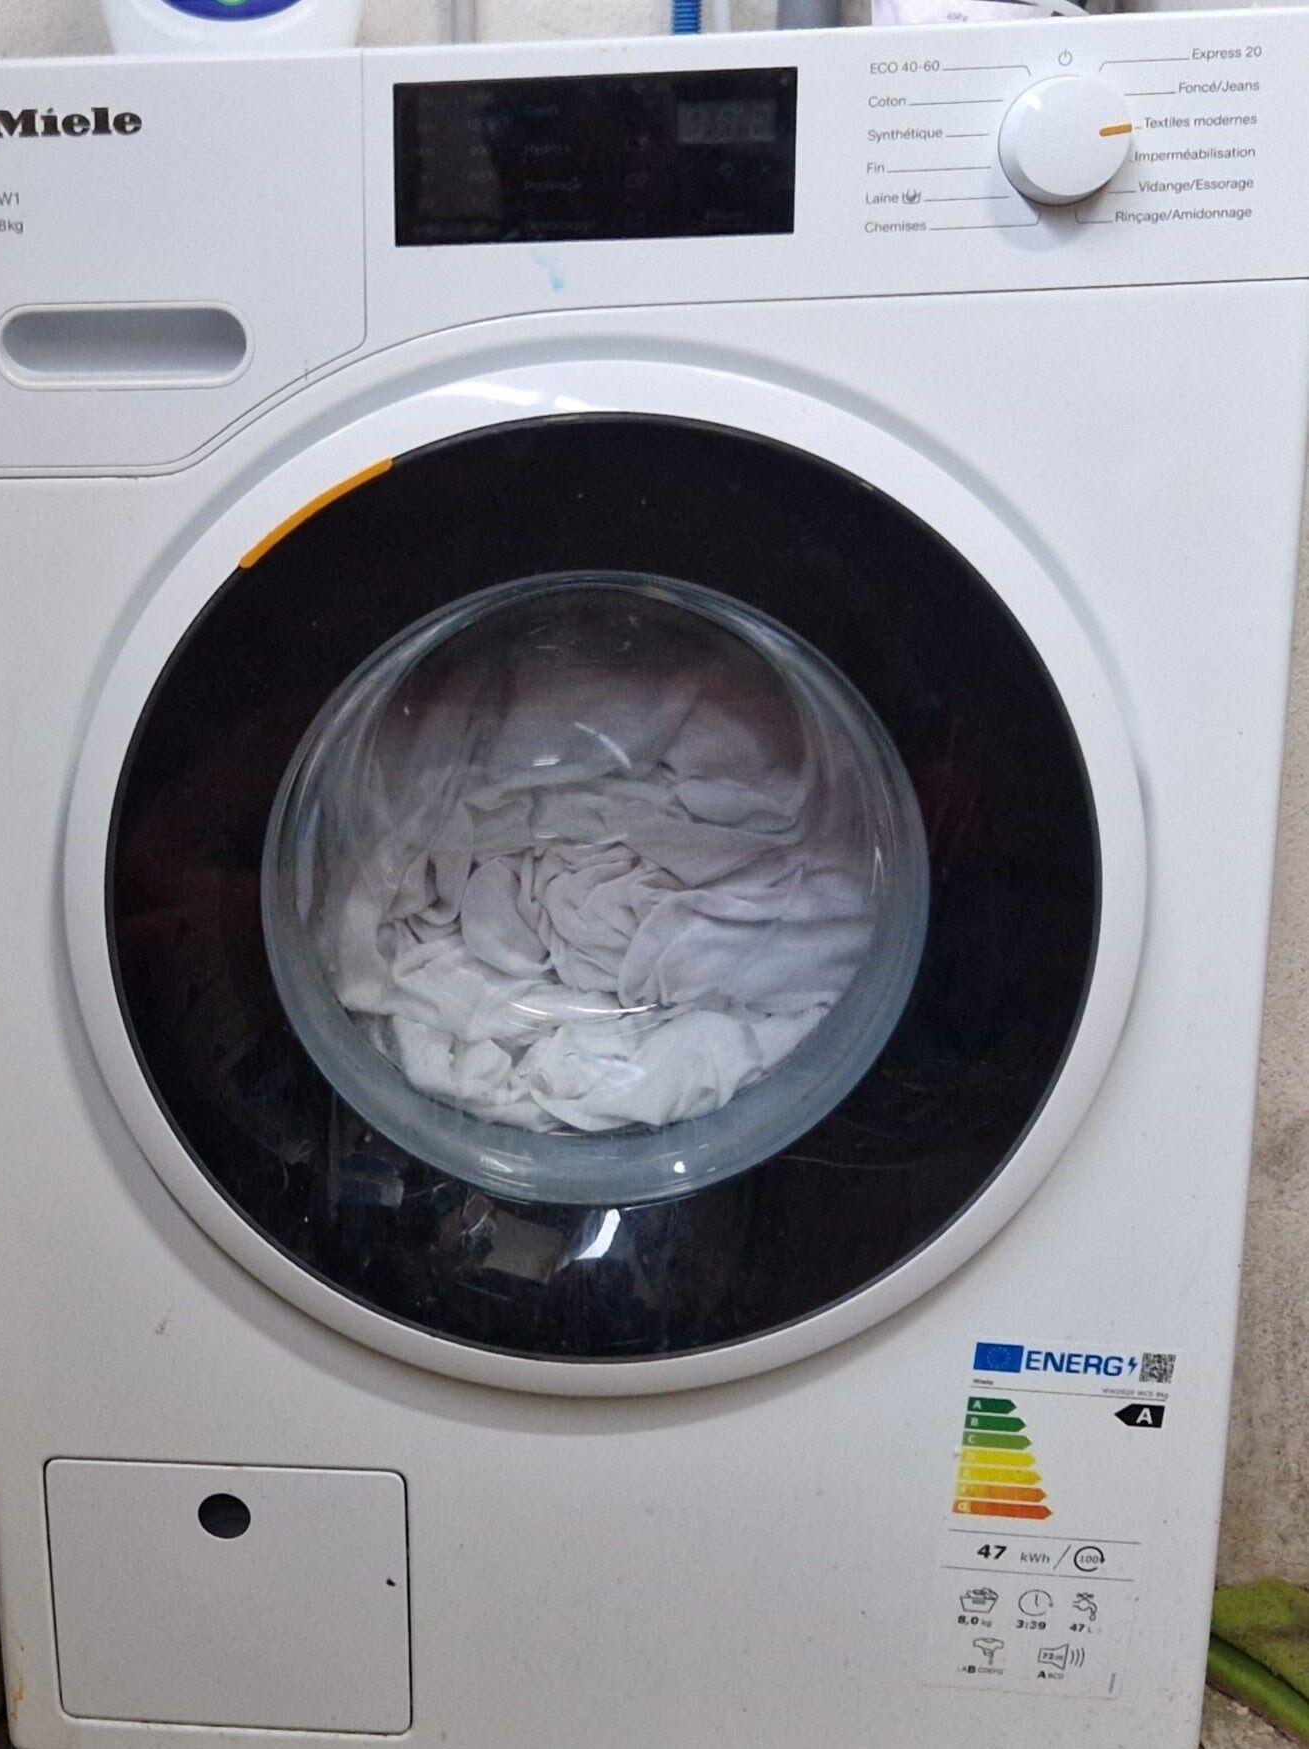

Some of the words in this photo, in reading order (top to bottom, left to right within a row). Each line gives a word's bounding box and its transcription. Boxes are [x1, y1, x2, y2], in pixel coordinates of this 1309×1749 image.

[1192, 46, 1242, 64] Express
[1245, 46, 1263, 58] 20
[869, 60, 898, 75] ECO
[900, 59, 941, 74] 40-60
[1178, 80, 1260, 95] Foncé/Jeans
[868, 95, 907, 108] Coton
[1144, 116, 1191, 129] Textiles
[1193, 114, 1258, 127] modernes
[867, 128, 943, 144] Synthétique
[1134, 146, 1256, 164] Imperméabilisation
[866, 161, 886, 174] Fin
[1138, 177, 1255, 194] Vidange/Essorage
[865, 191, 899, 205] Laine
[1115, 207, 1253, 225] Rinçage/Amidonnage
[864, 219, 927, 234] Chemises
[1025, 1350, 1125, 1377] ENERG
[971, 1399, 982, 1410] A
[970, 1416, 980, 1427] B
[1136, 1407, 1154, 1425] A
[977, 1544, 1007, 1560] 47
[1020, 1551, 1051, 1564] kWh
[1079, 1555, 1099, 1564] 100
[1015, 1619, 1047, 1630] 3:39
[1069, 1622, 1085, 1633] 47
